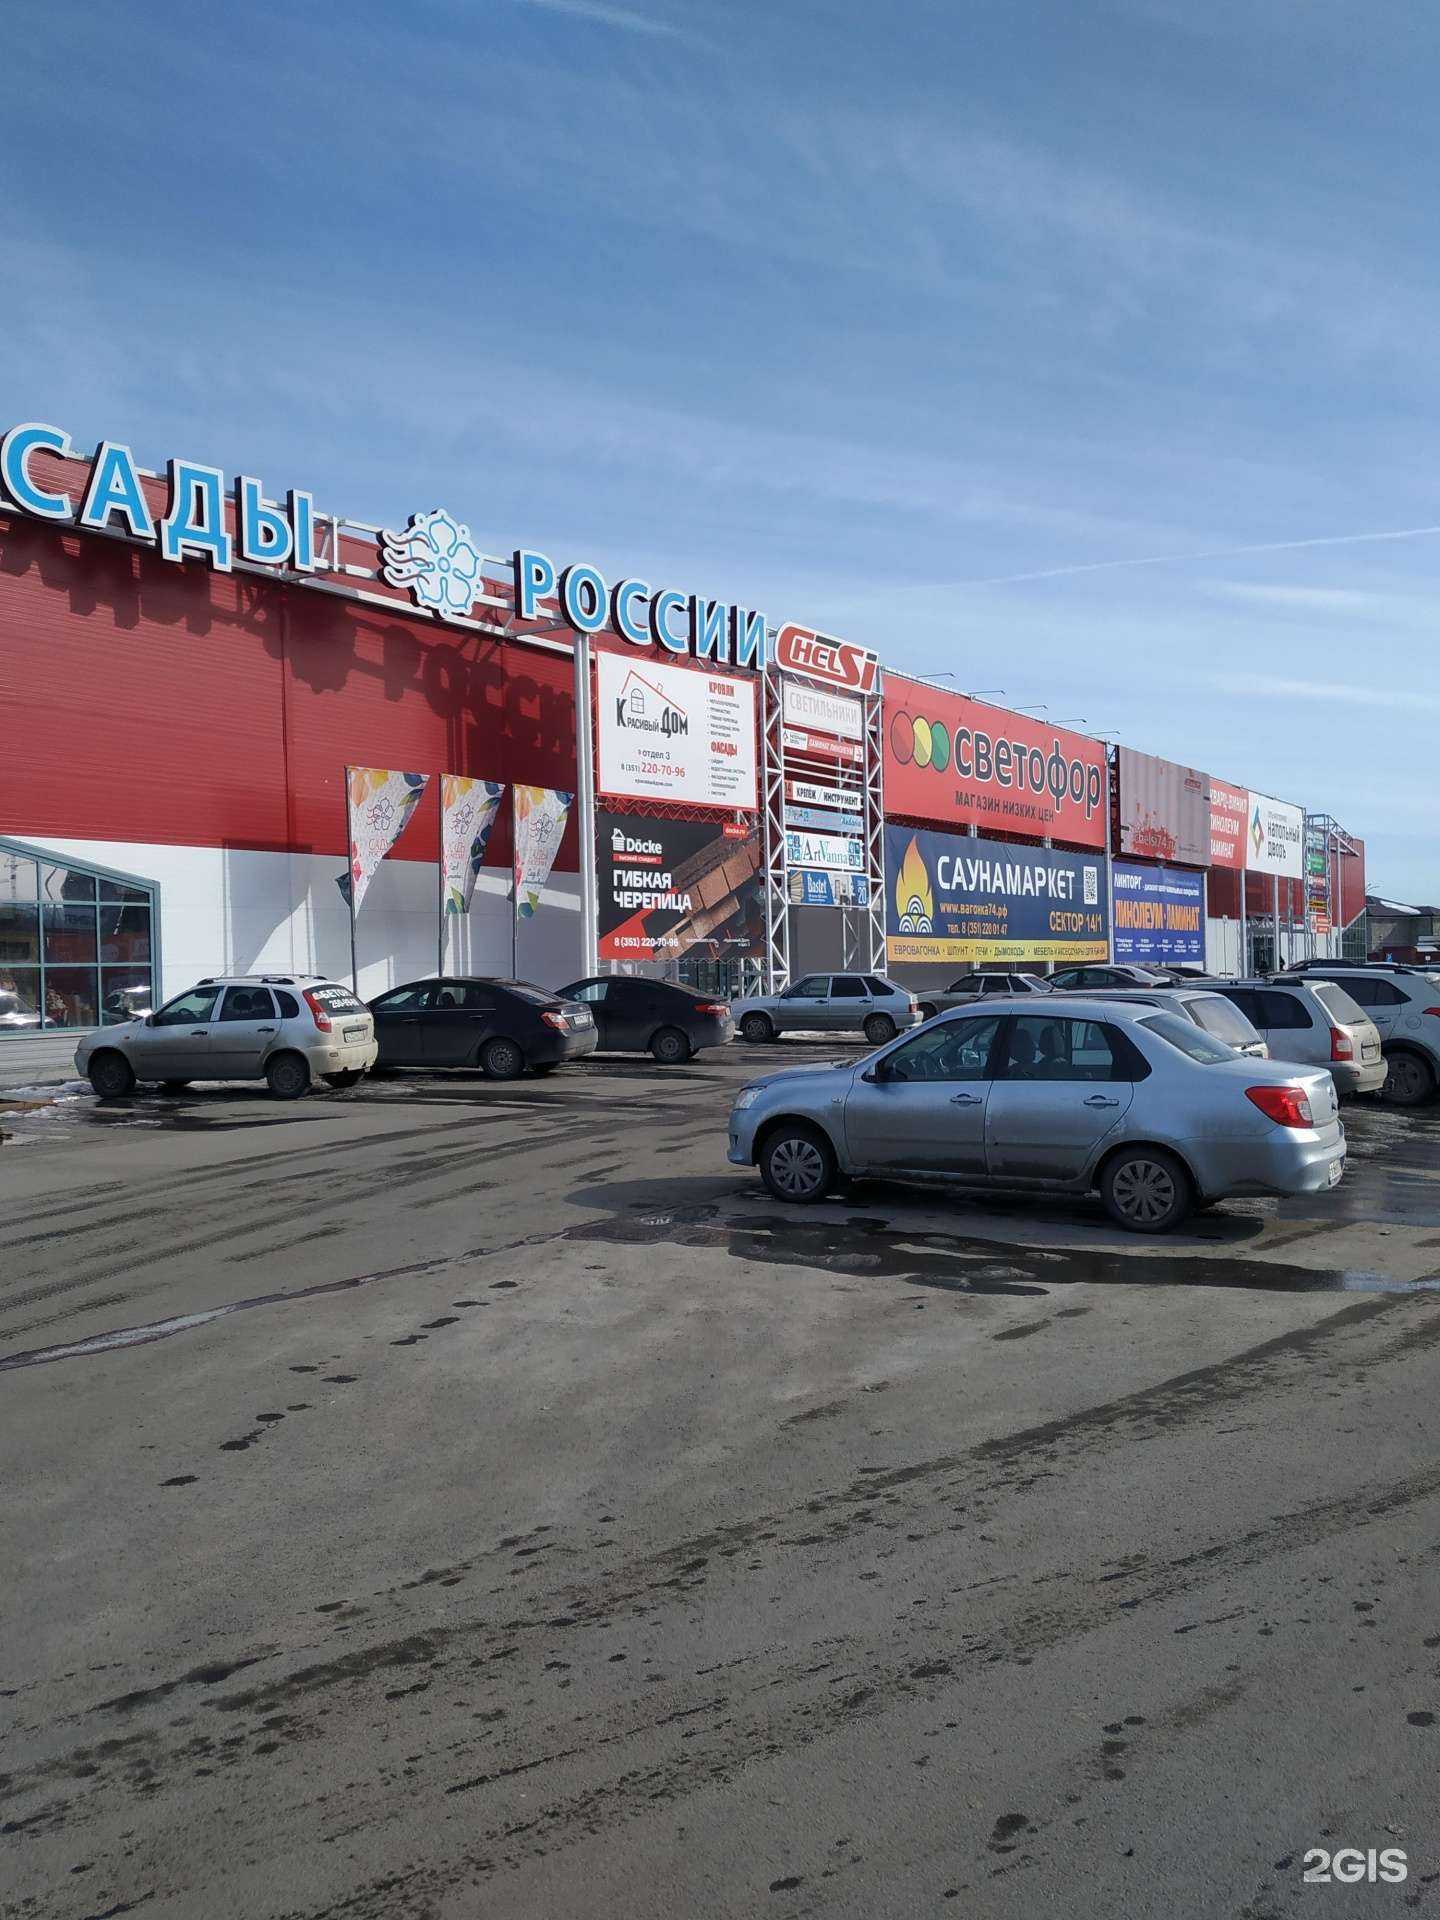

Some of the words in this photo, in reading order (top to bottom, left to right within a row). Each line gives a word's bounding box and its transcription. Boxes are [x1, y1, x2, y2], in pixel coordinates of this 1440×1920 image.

[0, 422, 315, 573] САДЫ
[513, 550, 768, 671] РОССИИ
[789, 691, 858, 722] СВЕТИЛЬНИКИ
[642, 750, 664, 760] отдел
[710, 741, 738, 758] ФАСАДЫ
[641, 762, 686, 778] 220-70-96
[823, 791, 859, 806] ИНСТРУМЕНТ
[955, 790, 1000, 813] МАГАЗИН
[1002, 801, 1036, 820] НИЗКИХ
[1039, 807, 1055, 824] ЦЕН
[626, 837, 663, 855] Döcke
[613, 869, 672, 890] ГИБКАЯ
[937, 856, 1076, 900] САУНАМАРКЕТ
[613, 891, 692, 913] ЧЕРЕПИЦА
[858, 886, 867, 904] 20
[939, 902, 1008, 919] www.вагонка74.рф
[1115, 900, 1163, 929] ЛИНОЛЕУМ
[961, 922, 966, 934] 8
[1049, 911, 1084, 933] СЕКТОР
[1086, 912, 1103, 933] 14/1
[614, 937, 620, 947] 8
[620, 936, 640, 948] (351)
[641, 937, 679, 948] 220-70-96
[894, 944, 940, 956] ЕВРОВАГОНКА
[946, 946, 969, 956] ШПУНТ
